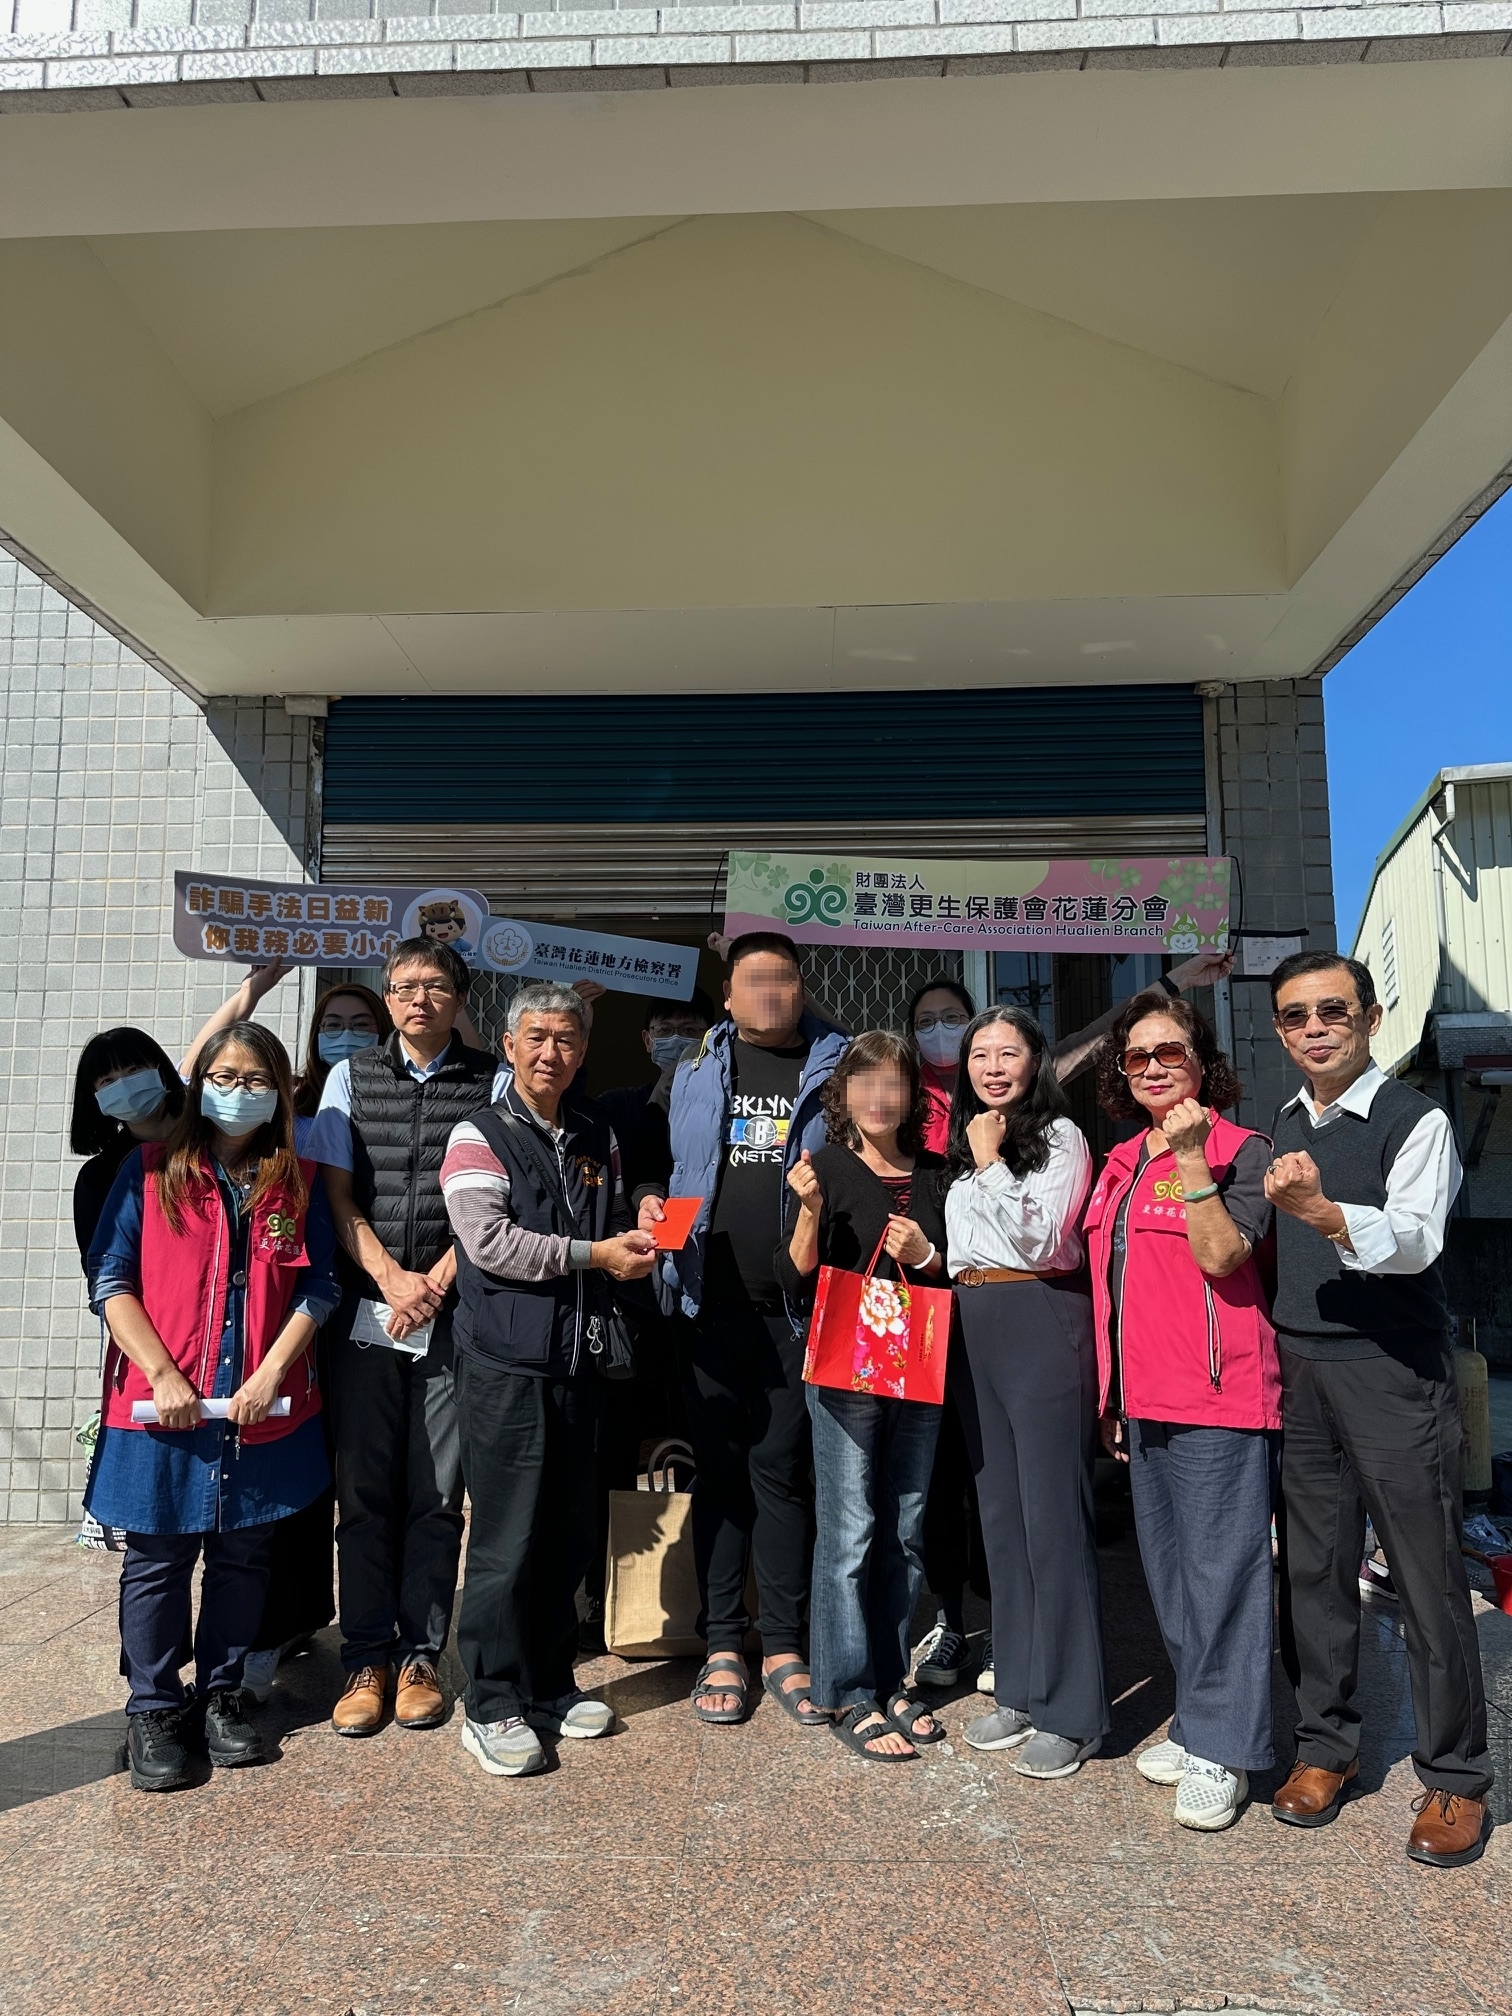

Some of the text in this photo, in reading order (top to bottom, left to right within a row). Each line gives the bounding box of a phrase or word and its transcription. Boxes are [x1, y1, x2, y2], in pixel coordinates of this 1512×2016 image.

[855, 872, 925, 891] 財團法人
[188, 885, 389, 923] 詐騙手法日益新
[853, 892, 1170, 921] 臺灣更生保護會花蓮分會
[853, 919, 1163, 936] Taiwan After-Care Association Hualien Branch
[533, 957, 679, 986] Taiwan Hualien District Prosecutors Office
[534, 942, 682, 978] 臺灣花蓮地方檢察署
[729, 1094, 798, 1117] BKLYN
[755, 1121, 767, 1145] B
